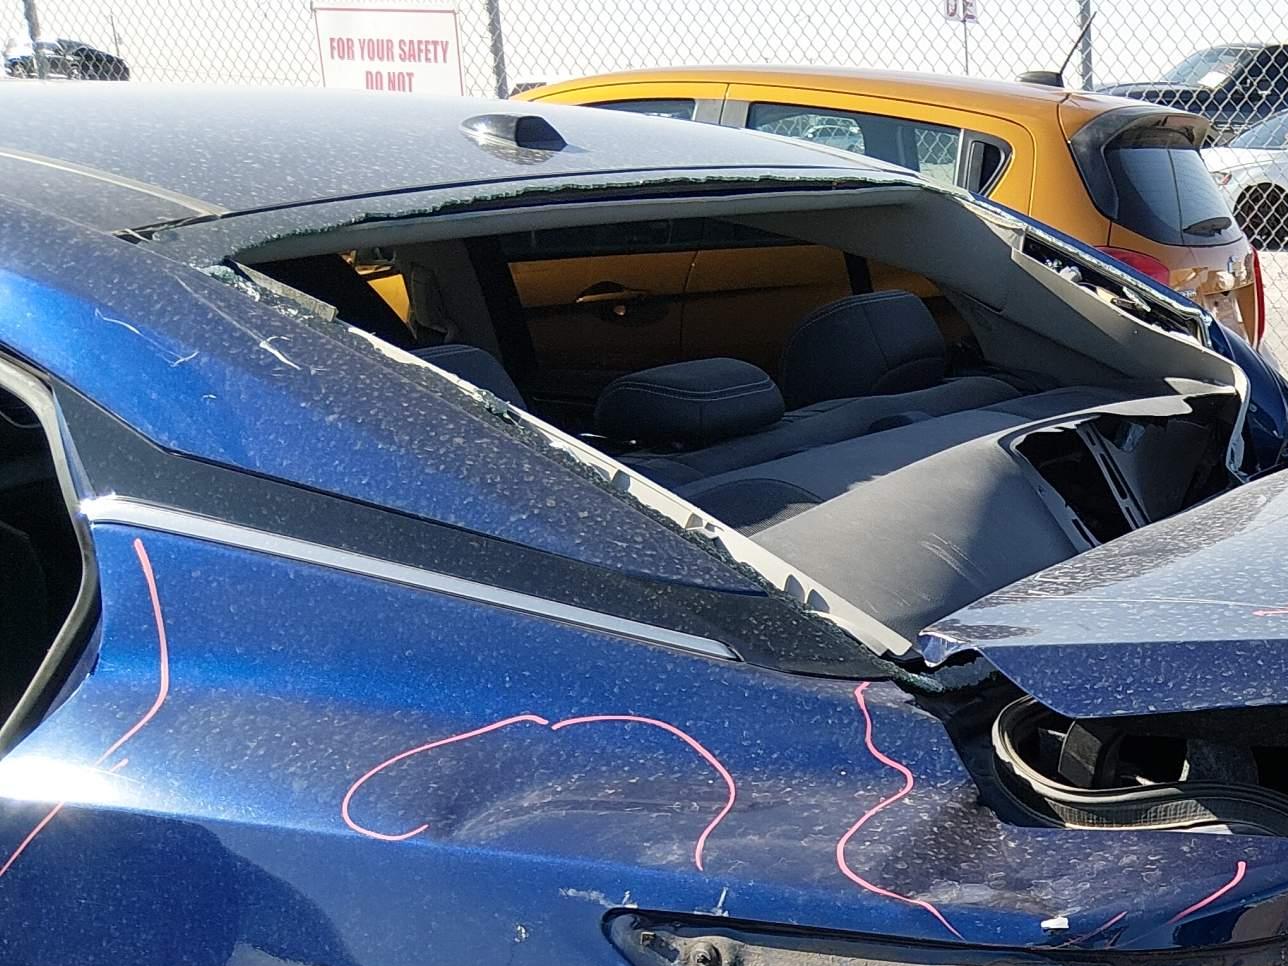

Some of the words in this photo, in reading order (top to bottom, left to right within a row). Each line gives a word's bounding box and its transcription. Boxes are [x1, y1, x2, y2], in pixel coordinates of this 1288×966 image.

[329, 37, 355, 61] FOR
[358, 38, 395, 62] YOUR
[398, 39, 449, 64] SAFETY
[366, 70, 384, 91] DO
[388, 71, 414, 93] NOT
